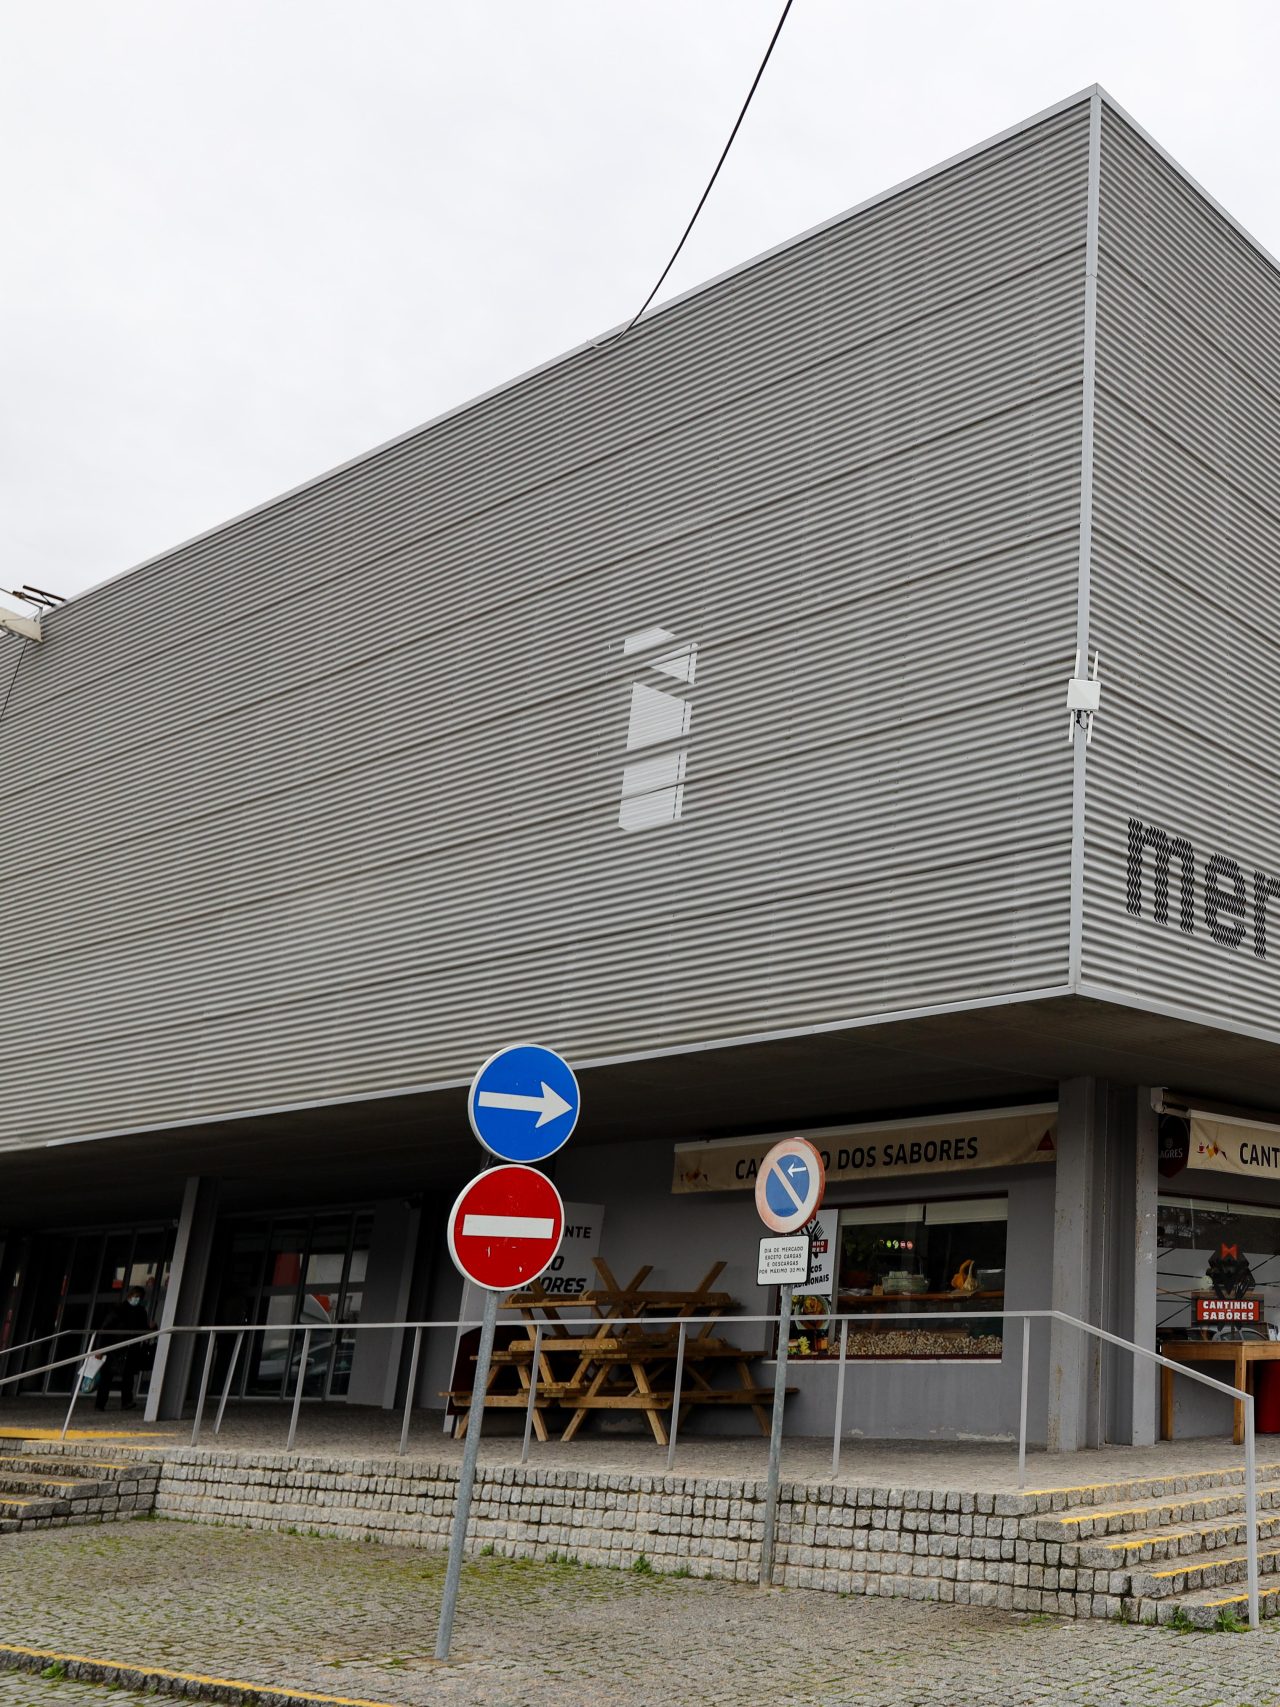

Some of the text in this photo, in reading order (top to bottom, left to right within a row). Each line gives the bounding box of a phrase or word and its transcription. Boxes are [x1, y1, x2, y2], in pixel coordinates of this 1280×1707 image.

[837, 1146, 877, 1171] DOS
[885, 1136, 979, 1165] SABORES
[1159, 1147, 1183, 1159] AGRES
[1202, 1300, 1254, 1310] CANTINHO
[1202, 1311, 1254, 1321] SABORES
